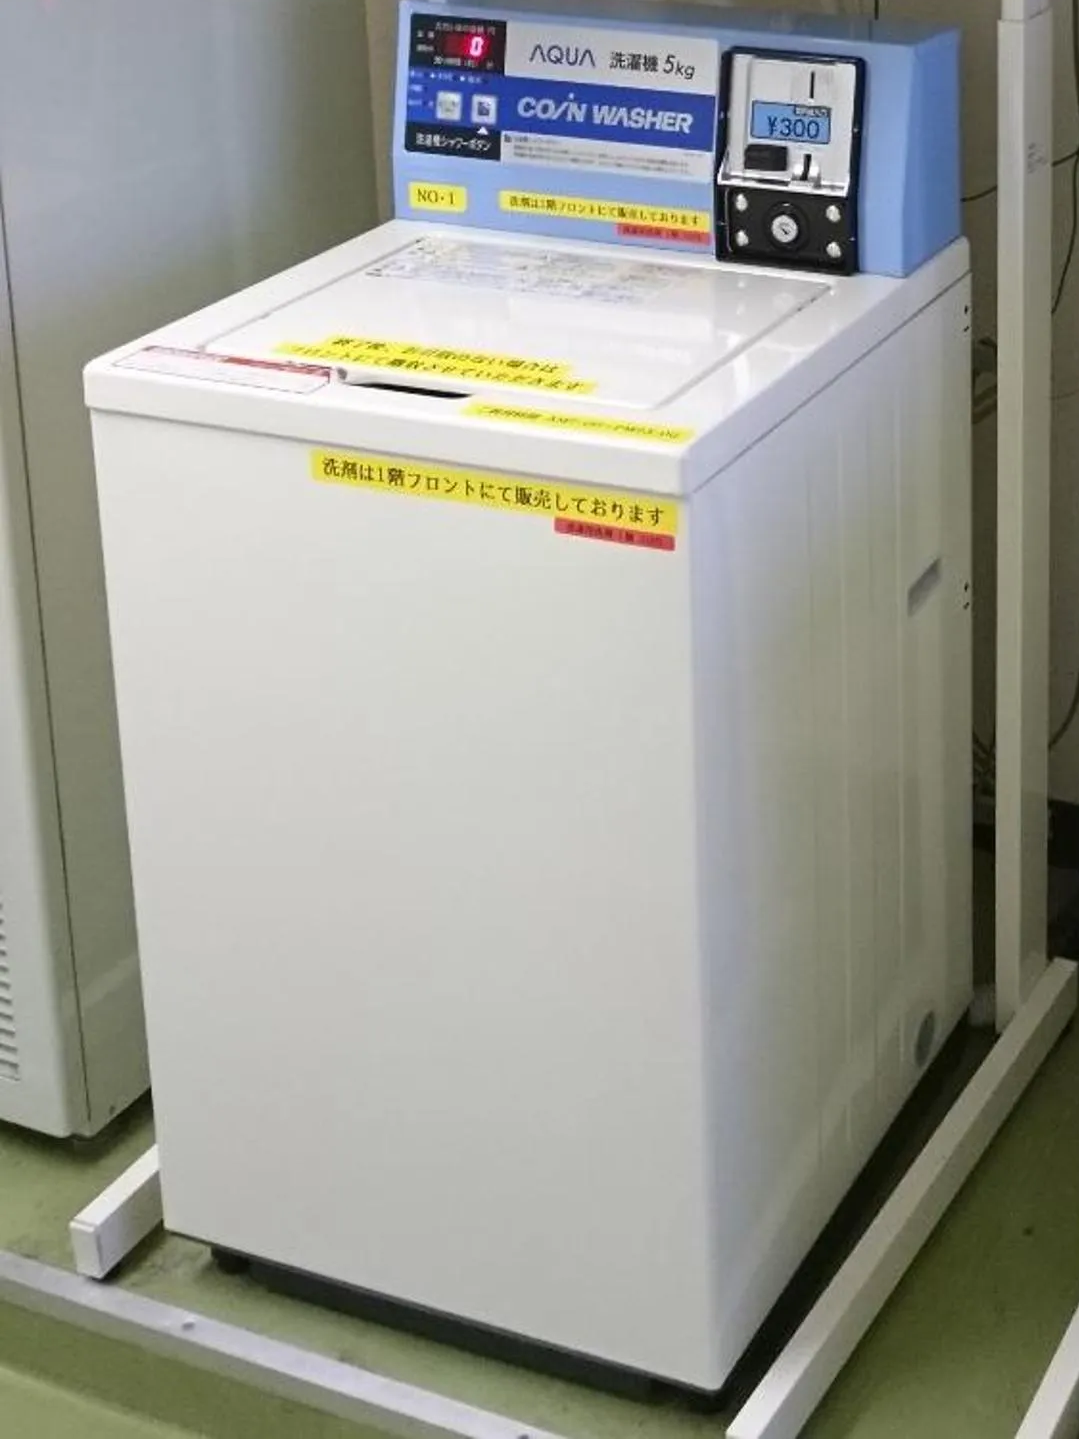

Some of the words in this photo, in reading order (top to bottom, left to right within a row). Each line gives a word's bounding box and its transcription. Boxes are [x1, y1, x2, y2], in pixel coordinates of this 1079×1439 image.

[469, 36, 483, 57] 0
[529, 43, 596, 68] AQUA
[609, 51, 659, 73] 洗濯機
[663, 54, 696, 80] 5kg
[592, 104, 694, 135] WASHER
[767, 115, 820, 140] ¥300
[323, 457, 665, 526] 洗剤は1階フロントにて販売しております
